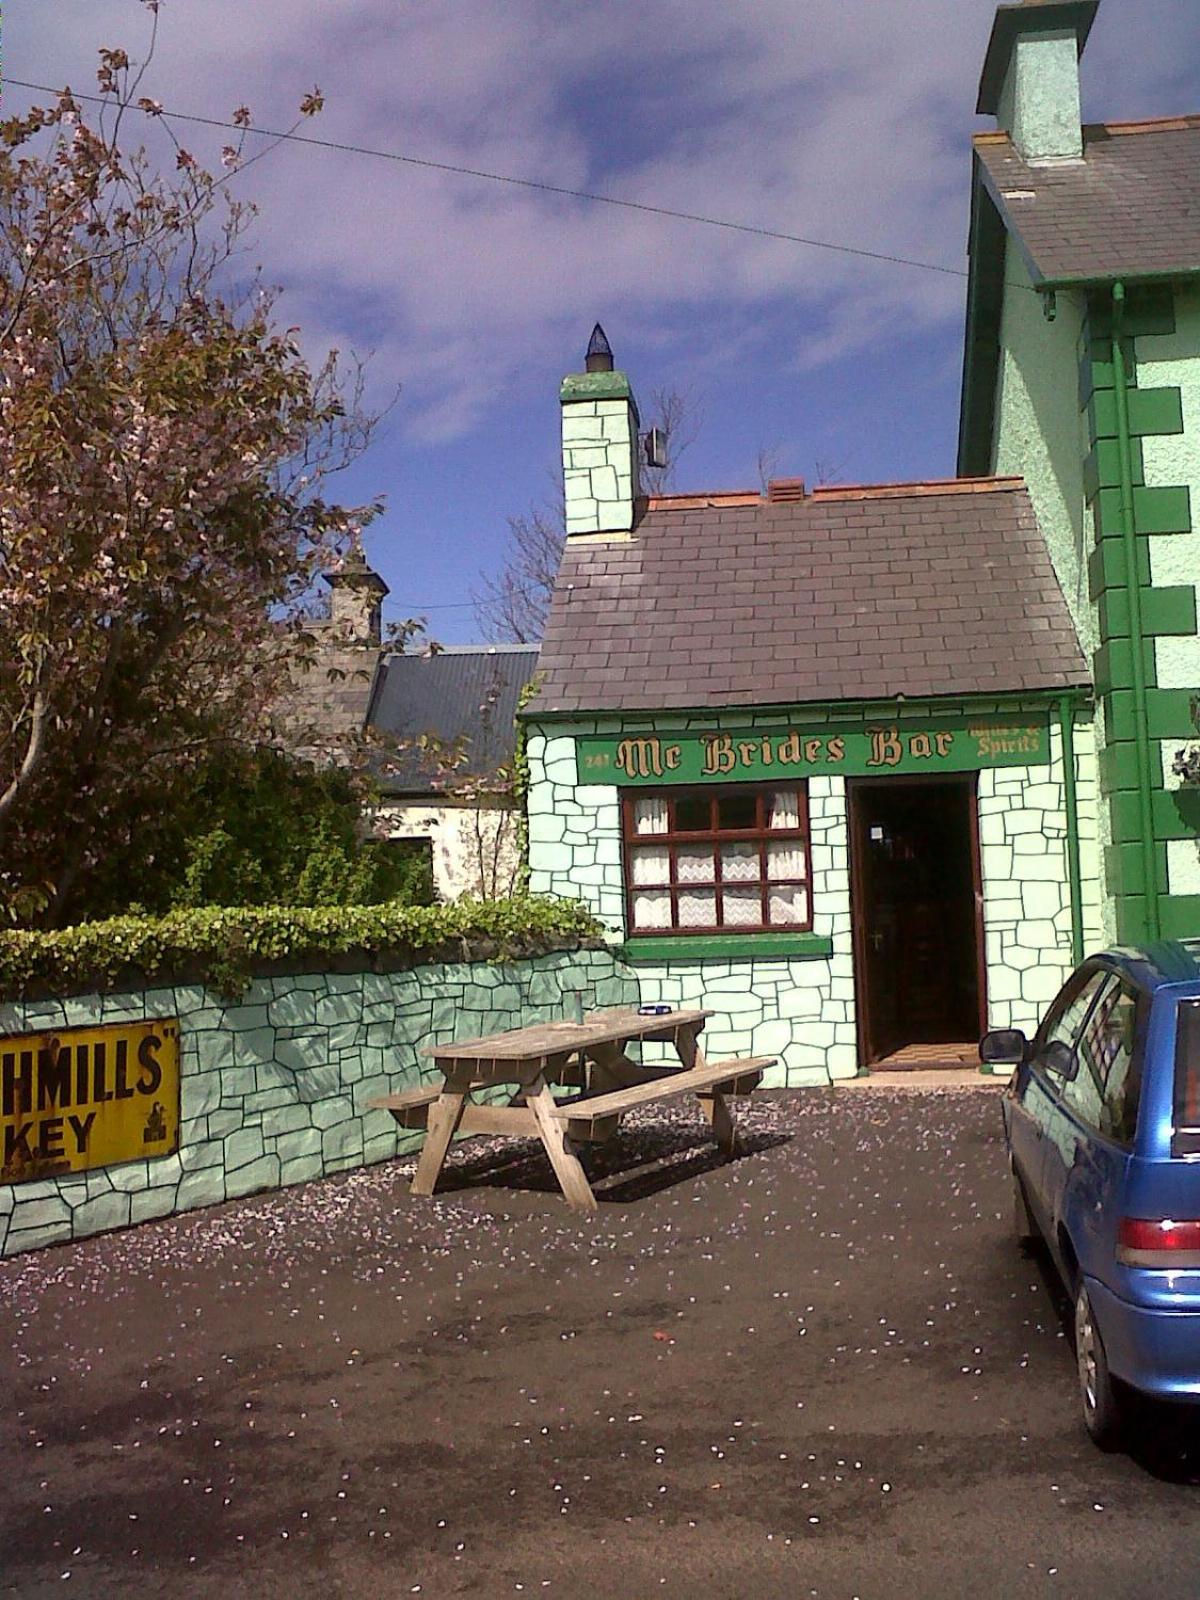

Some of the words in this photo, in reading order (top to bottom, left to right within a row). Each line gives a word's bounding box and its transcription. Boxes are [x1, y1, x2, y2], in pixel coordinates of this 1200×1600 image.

[615, 736, 683, 778] Mc
[699, 730, 846, 777] Brides
[864, 724, 954, 768] Bar
[4, 1111, 97, 1165] KEY
